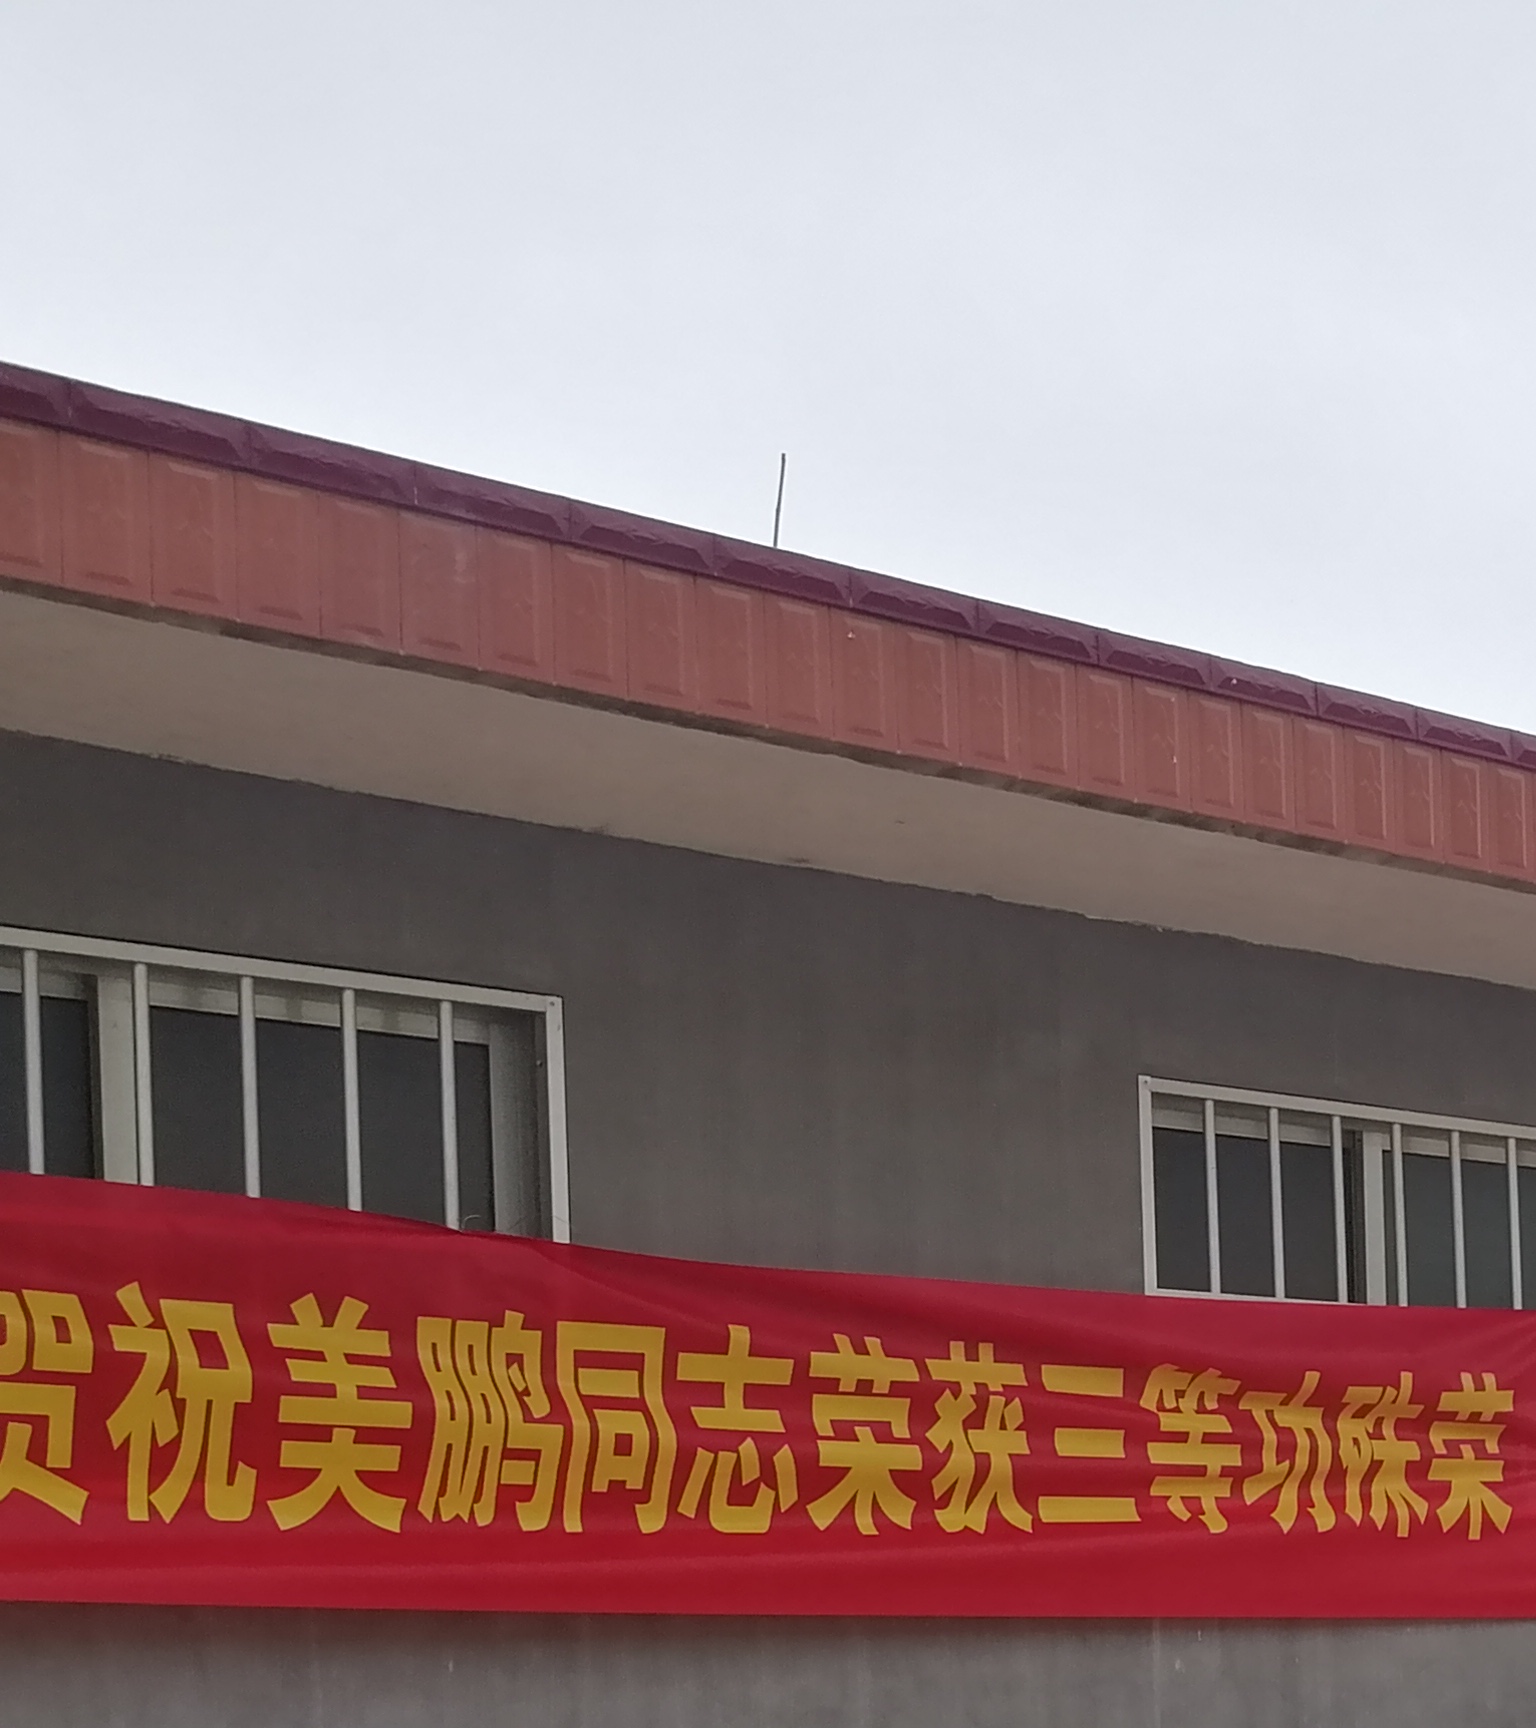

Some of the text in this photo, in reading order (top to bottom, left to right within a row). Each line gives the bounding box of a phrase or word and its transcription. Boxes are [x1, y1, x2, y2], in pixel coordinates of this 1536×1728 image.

[0, 1281, 1515, 1541] 贺祝美鹏同志荣获三等功殊荣
